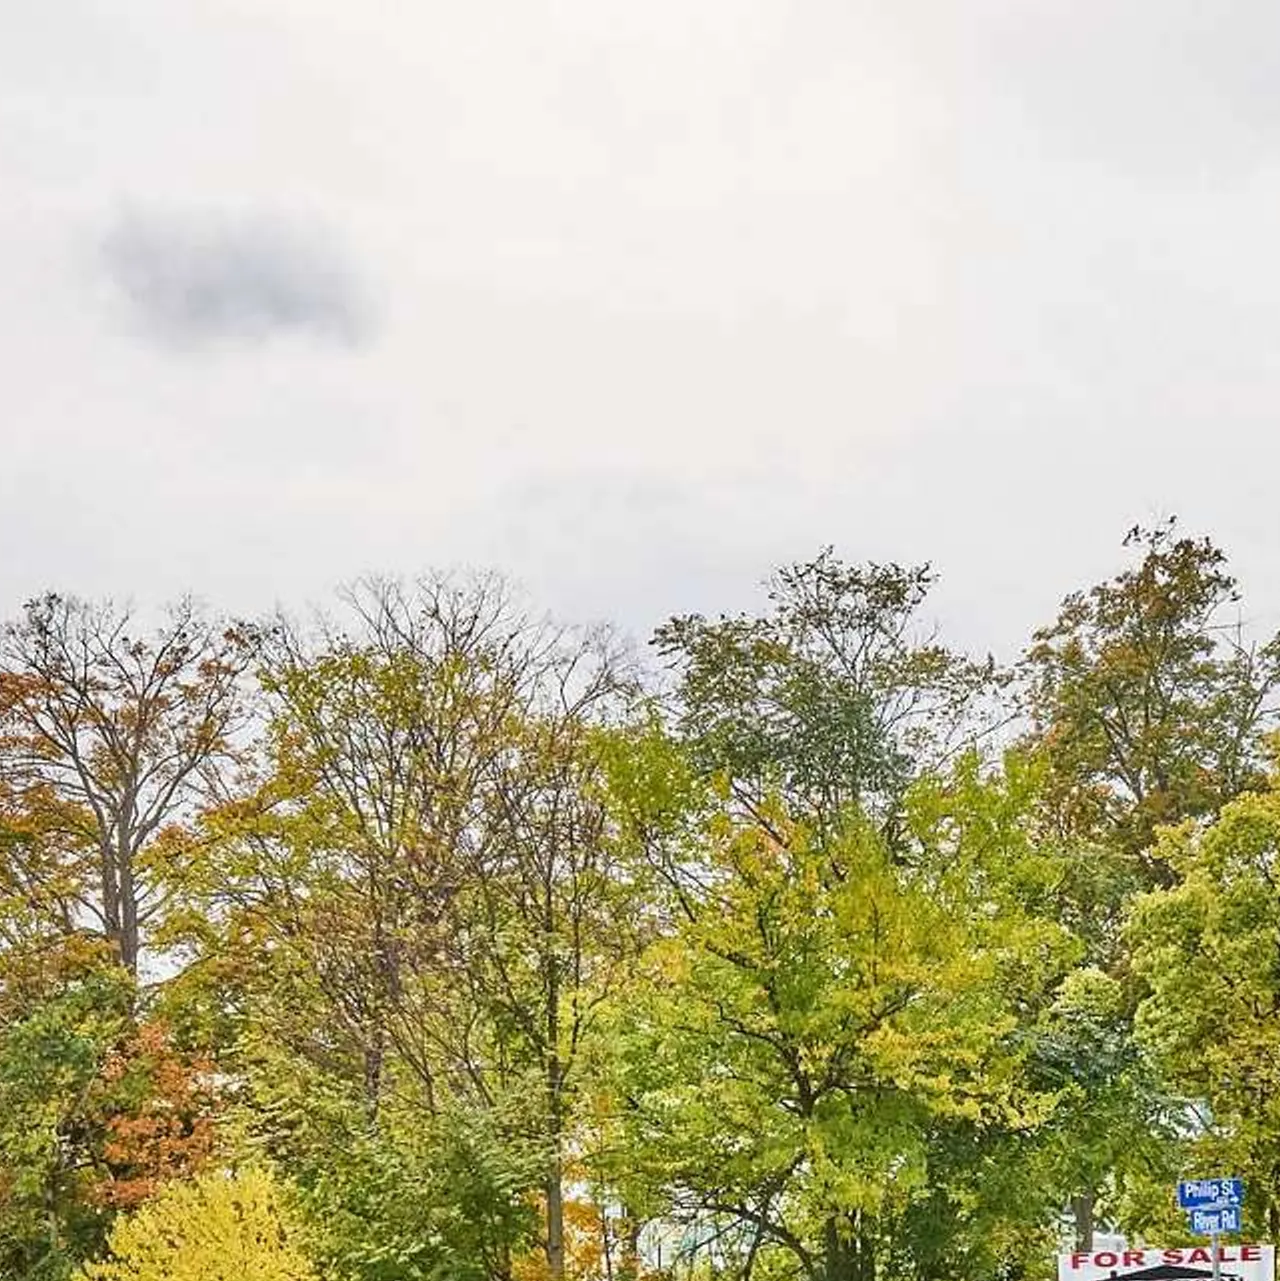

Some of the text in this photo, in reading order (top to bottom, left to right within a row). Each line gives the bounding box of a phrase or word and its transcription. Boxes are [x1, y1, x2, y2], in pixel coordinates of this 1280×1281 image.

[1185, 1182, 1220, 1201] Phillip
[1193, 1211, 1219, 1231] River
[1071, 1245, 1262, 1269] FOR SALE
